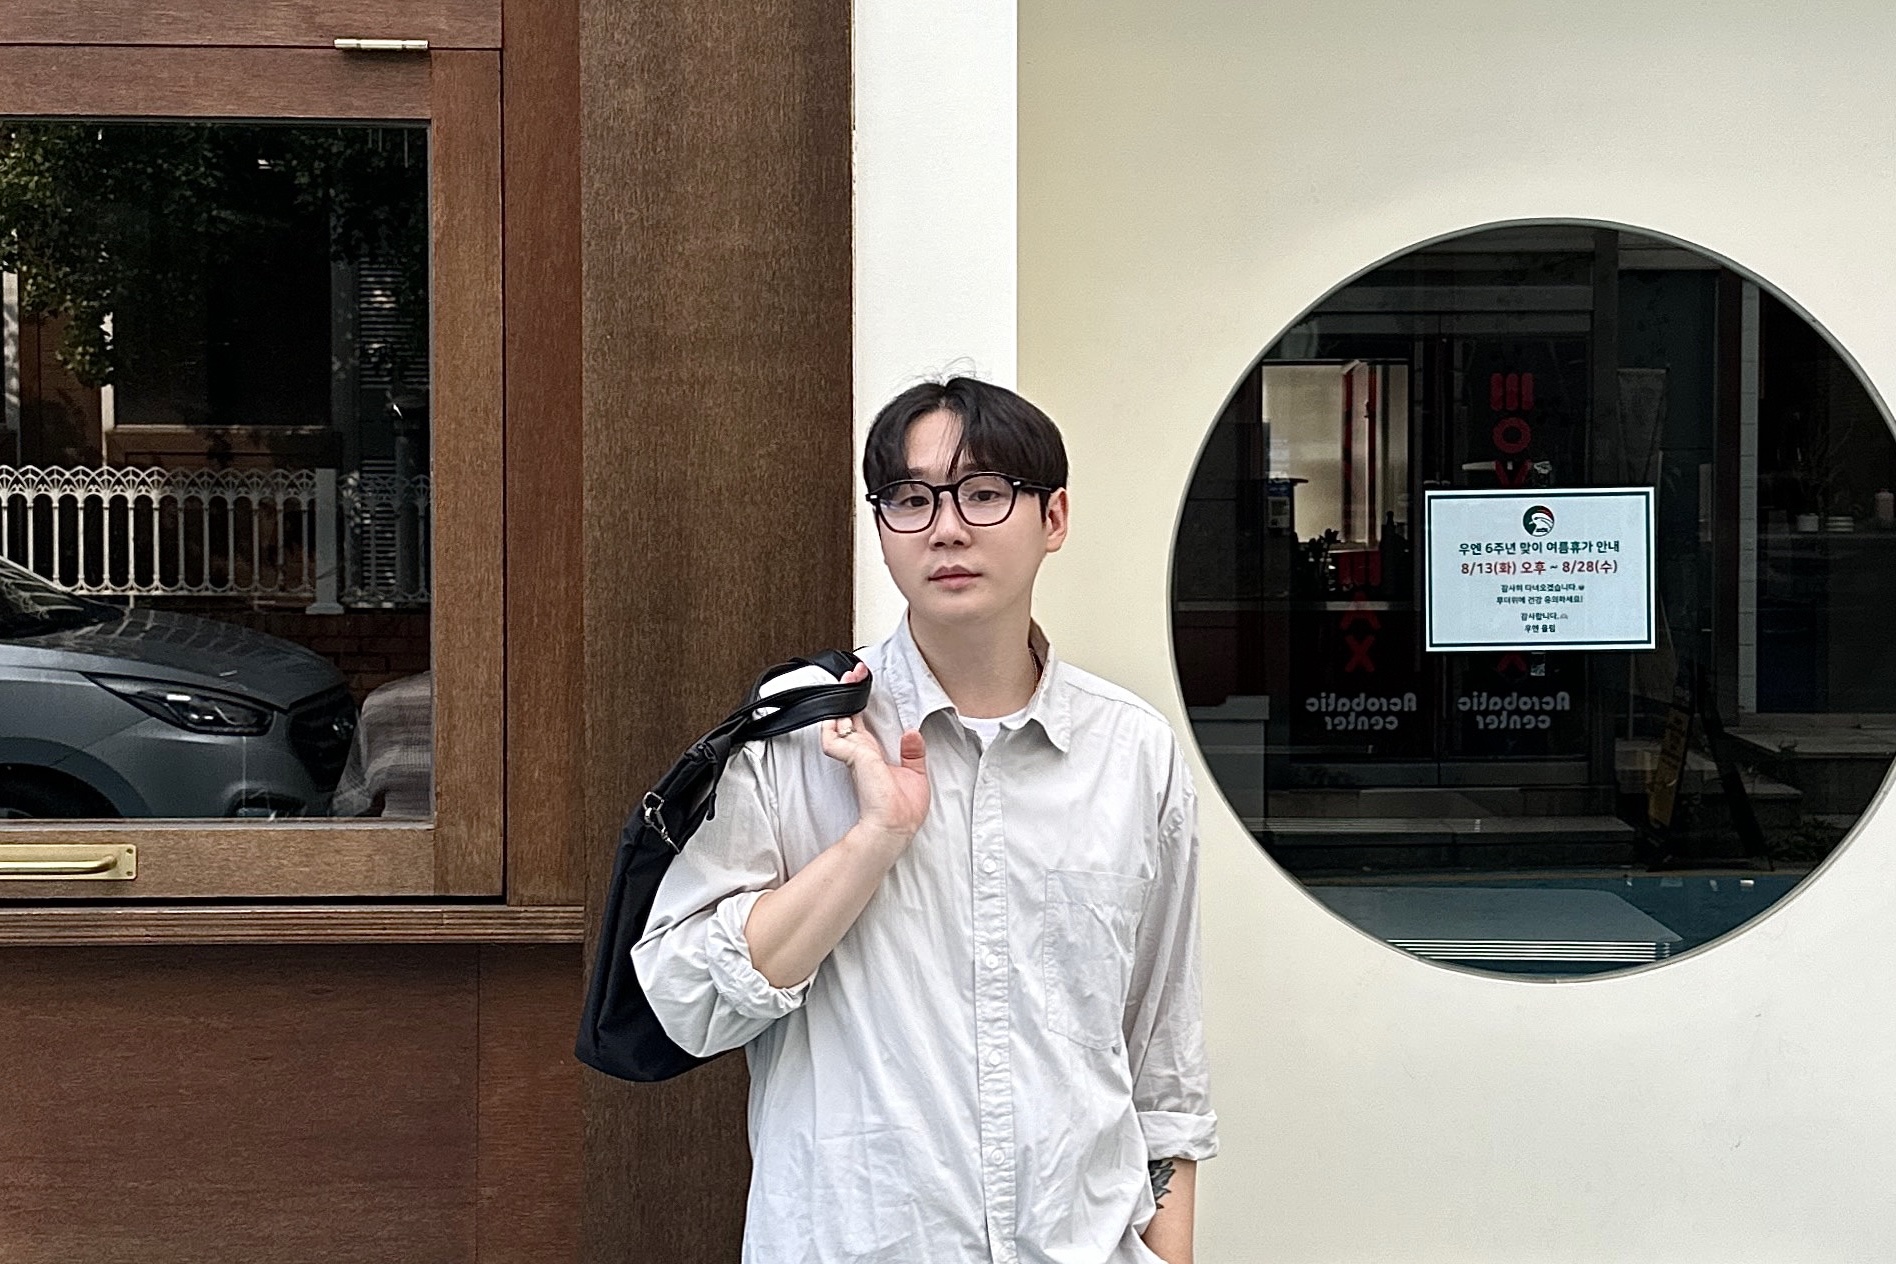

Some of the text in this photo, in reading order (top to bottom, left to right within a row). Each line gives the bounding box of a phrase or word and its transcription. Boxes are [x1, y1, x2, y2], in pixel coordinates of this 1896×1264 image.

[1458, 540, 1620, 556] 우엔 6주년 맞이 여름휴가 안내
[1460, 561, 1517, 576] 8/13(화)
[1520, 560, 1547, 575] 오후
[1561, 559, 1618, 575] 8/28(수)
